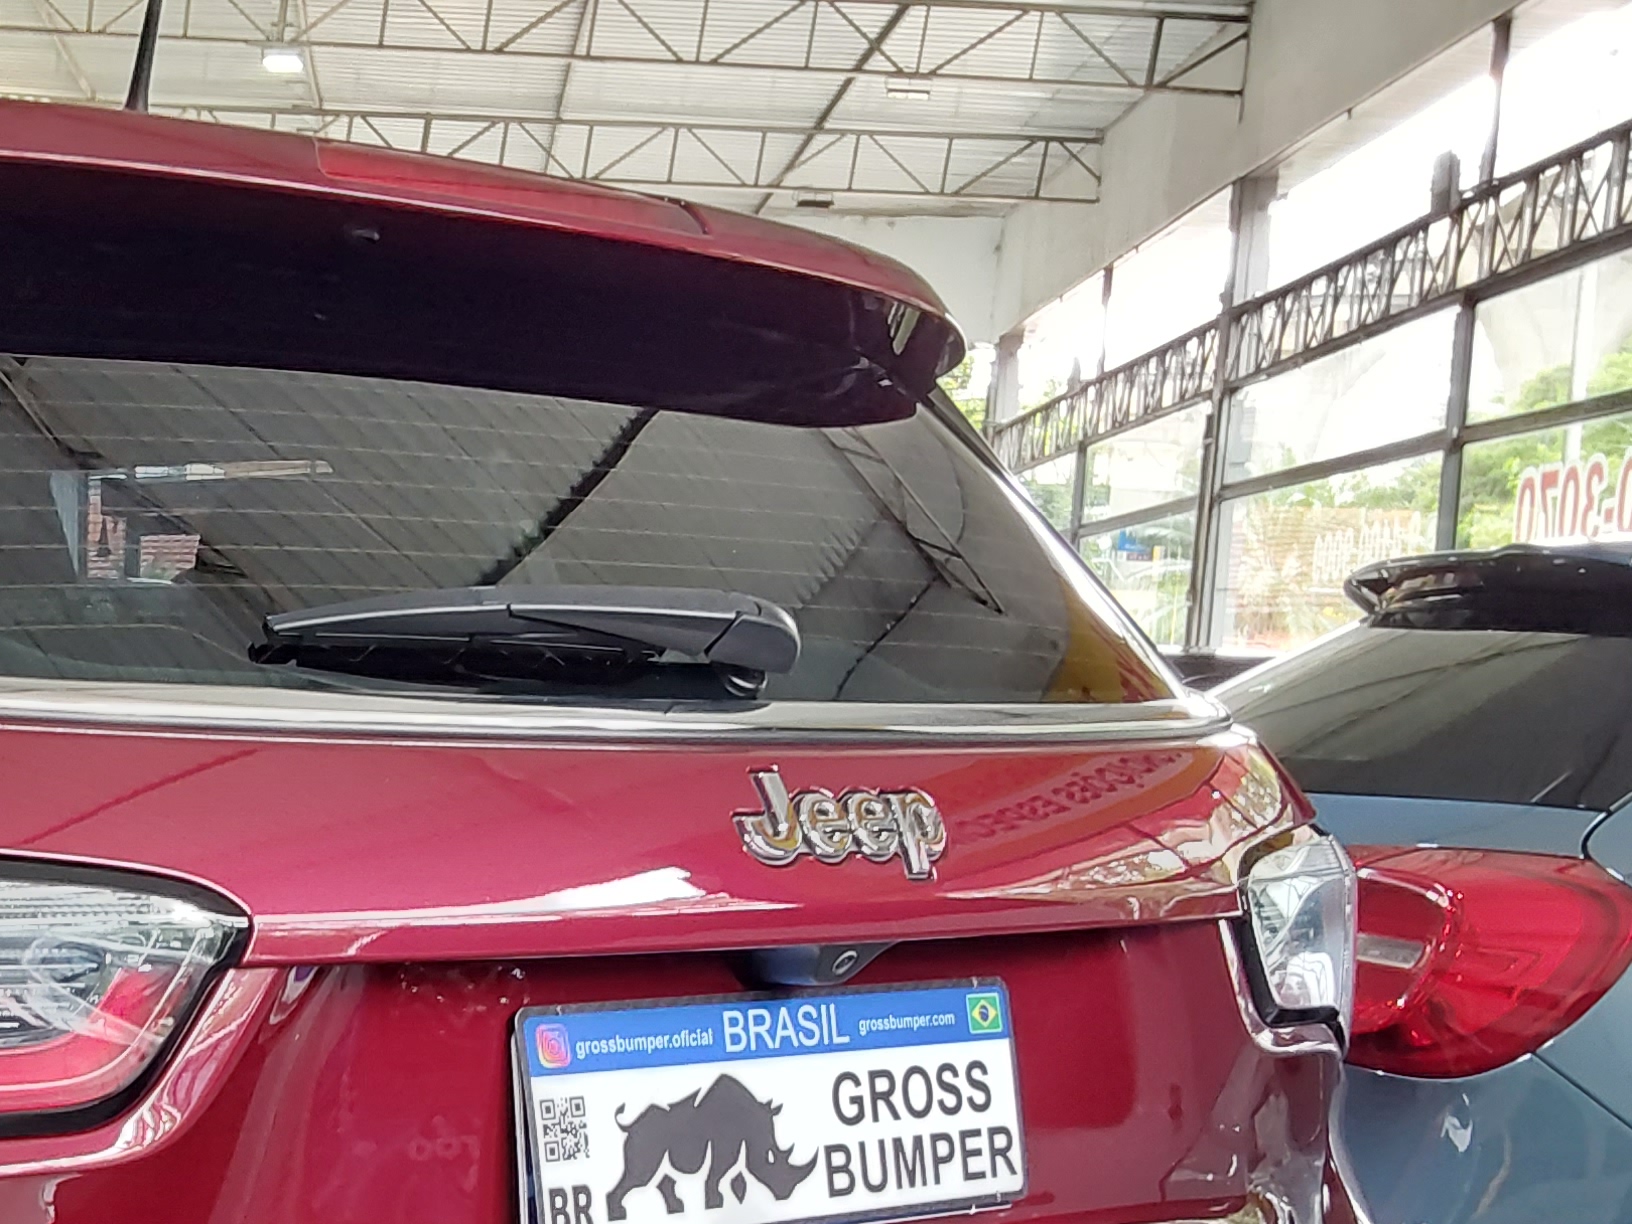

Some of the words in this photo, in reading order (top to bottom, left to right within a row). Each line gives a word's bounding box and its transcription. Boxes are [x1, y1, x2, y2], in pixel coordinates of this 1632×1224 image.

[730, 764, 947, 881] Jeep
[575, 1027, 714, 1060] grossbumper.oficial
[722, 1003, 851, 1053] BRASIL
[858, 1012, 956, 1037] grossbumper.com
[831, 1059, 992, 1126] GROSS
[824, 1125, 1018, 1199] BUMPER
